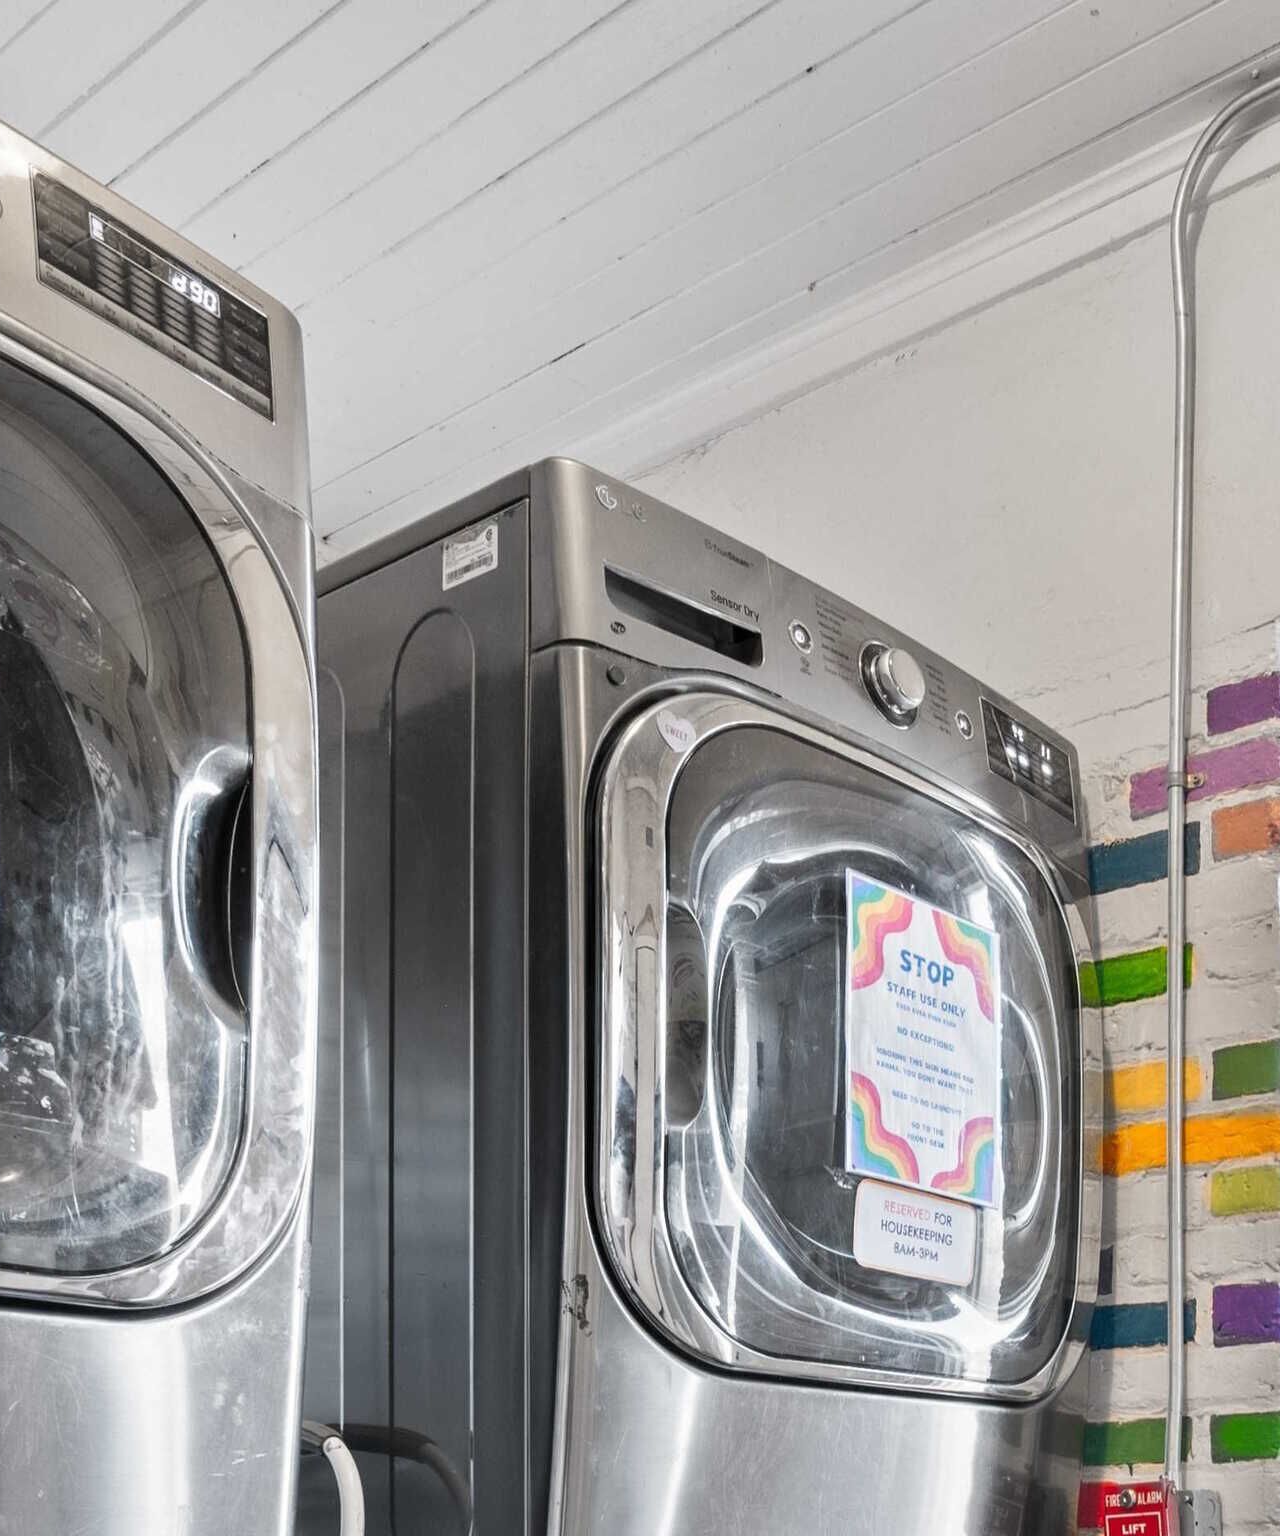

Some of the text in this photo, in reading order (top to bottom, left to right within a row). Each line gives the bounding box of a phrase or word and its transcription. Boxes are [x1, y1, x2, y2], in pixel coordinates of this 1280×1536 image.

[710, 589, 760, 623] Sensor Dry
[900, 949, 954, 987] STOP
[887, 981, 966, 1018] STAFF USE ONLY
[884, 1199, 952, 1228] RESERVED FOR
[880, 1218, 953, 1247] HOUSEKEEPING
[894, 1241, 939, 1262] 8AM-3PM
[1105, 1491, 1163, 1508] FIRE ALARM
[1122, 1523, 1146, 1535] LIFT
